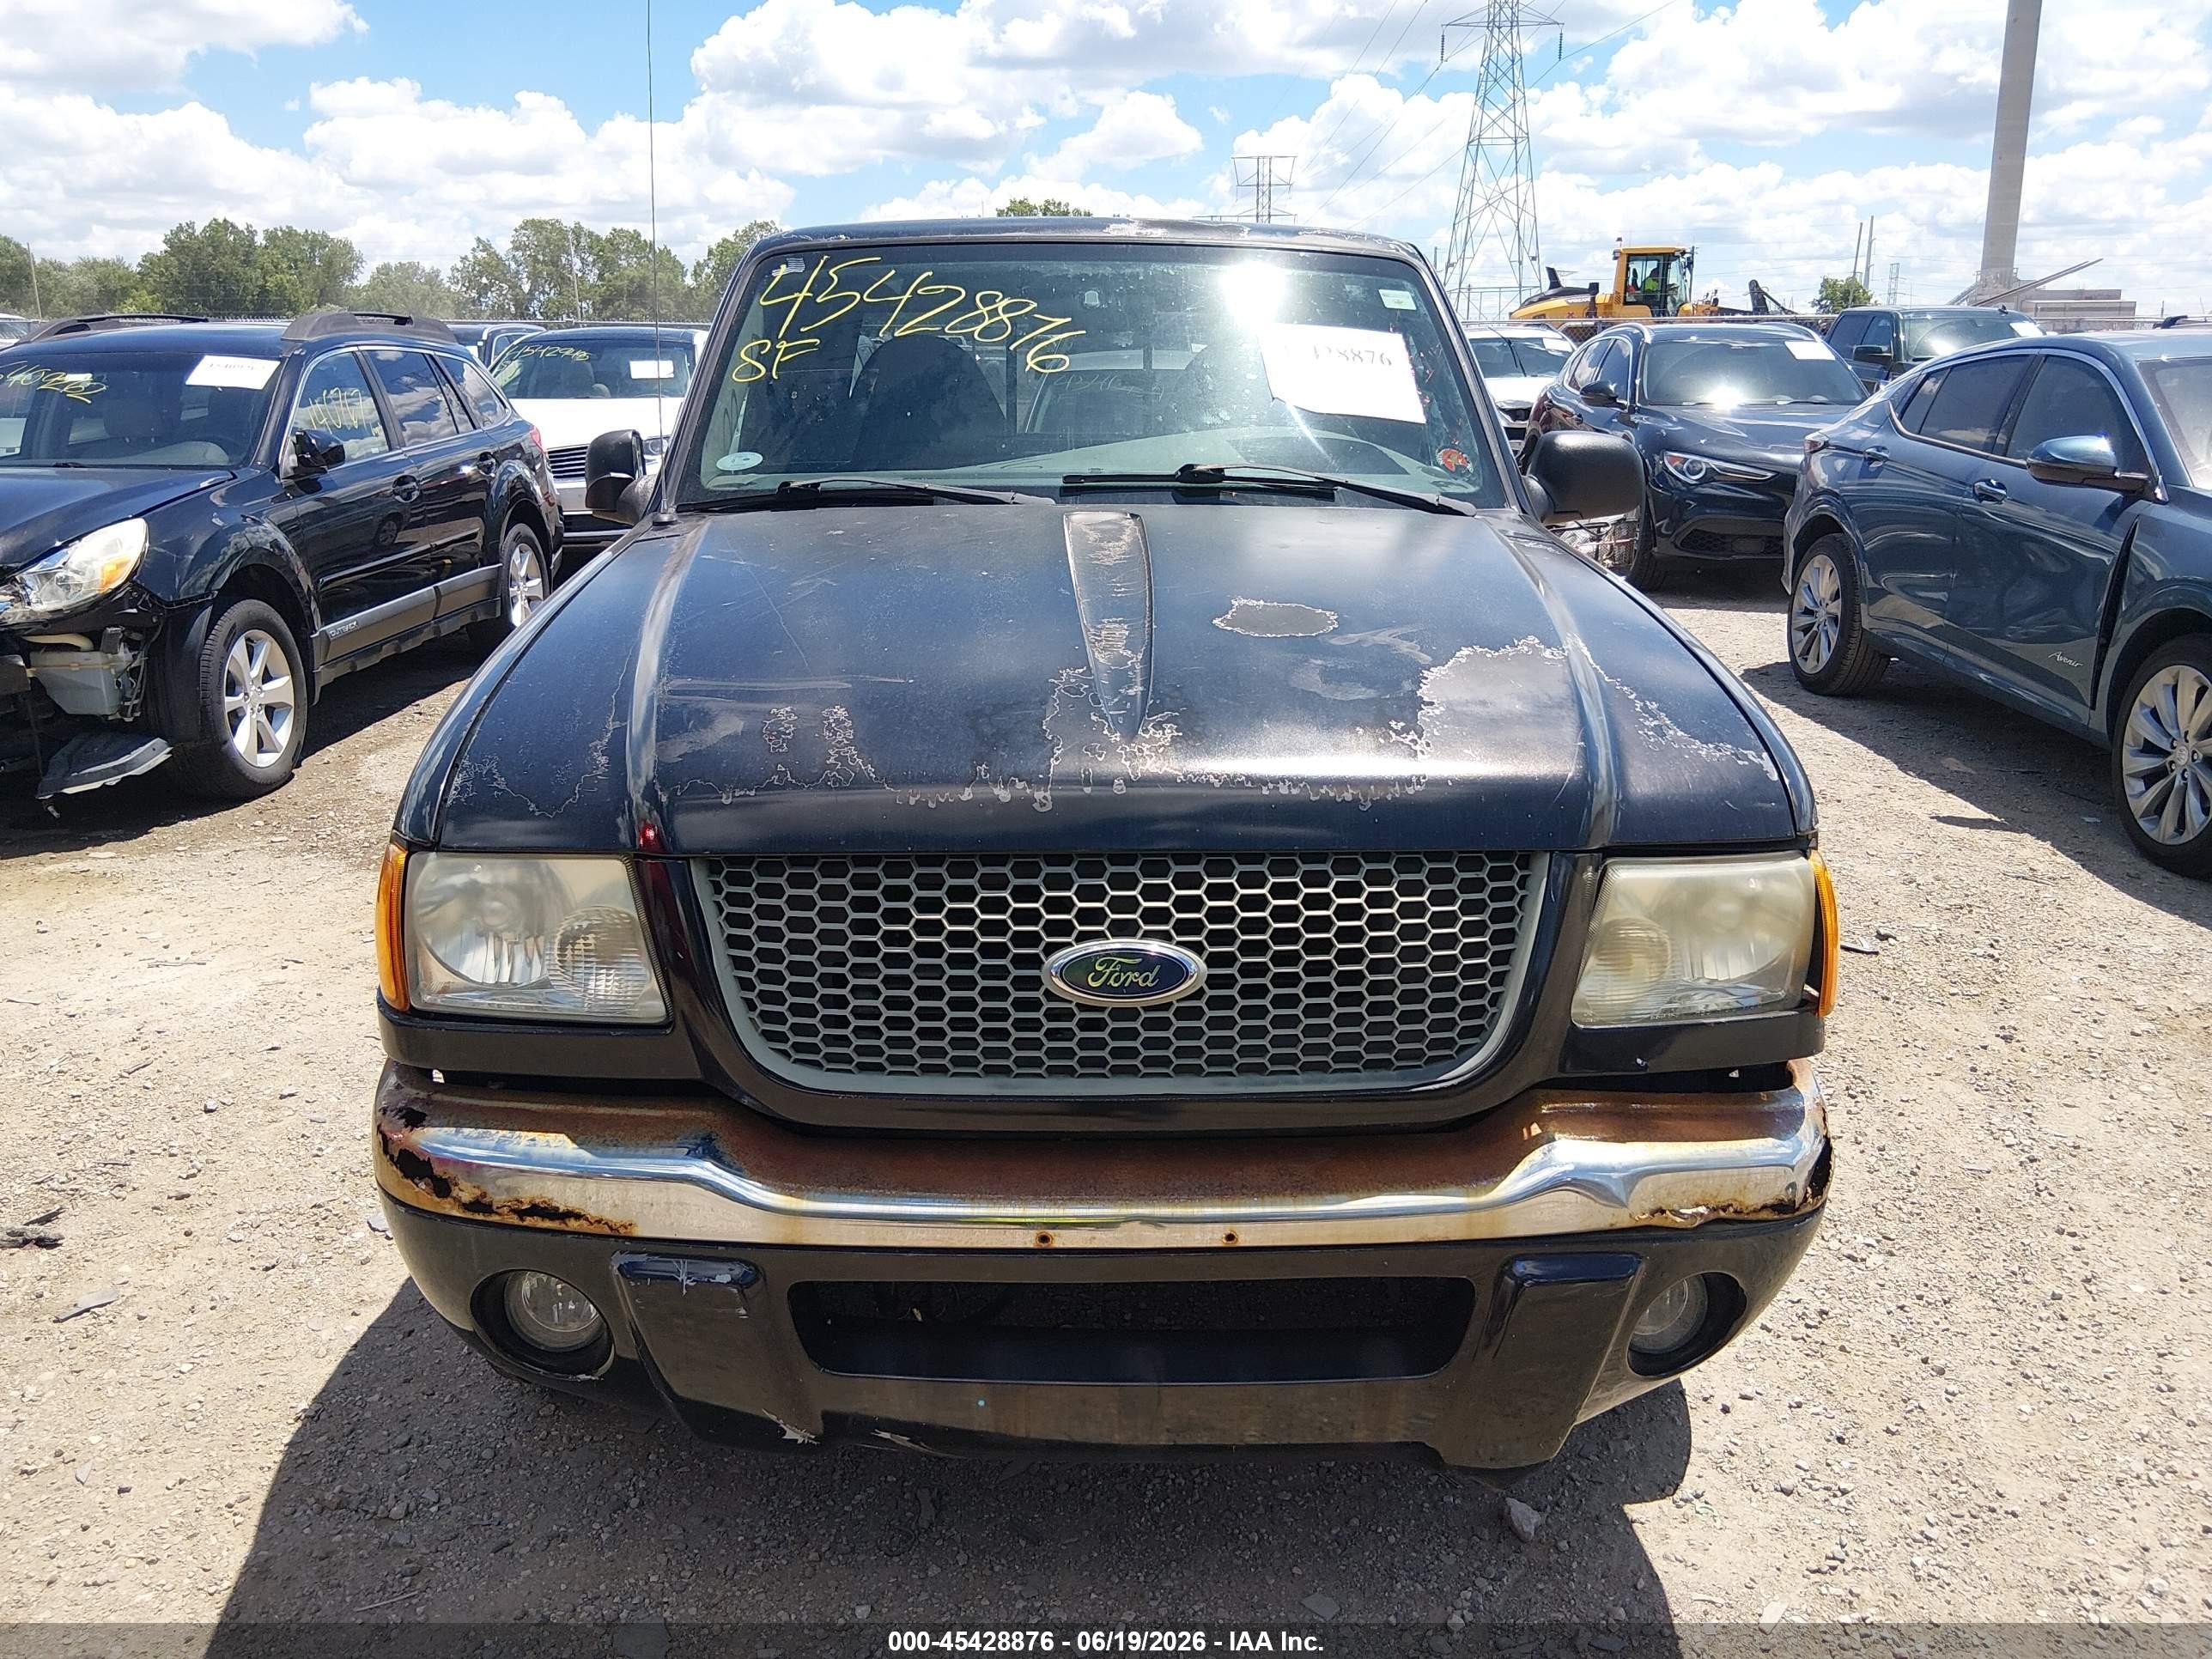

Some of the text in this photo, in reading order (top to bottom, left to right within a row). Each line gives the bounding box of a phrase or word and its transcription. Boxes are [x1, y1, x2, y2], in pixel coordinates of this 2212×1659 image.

[759, 255, 1087, 374] 45428876
[2046, 651, 2085, 667] Avenir
[1087, 956, 1161, 988] Ford
